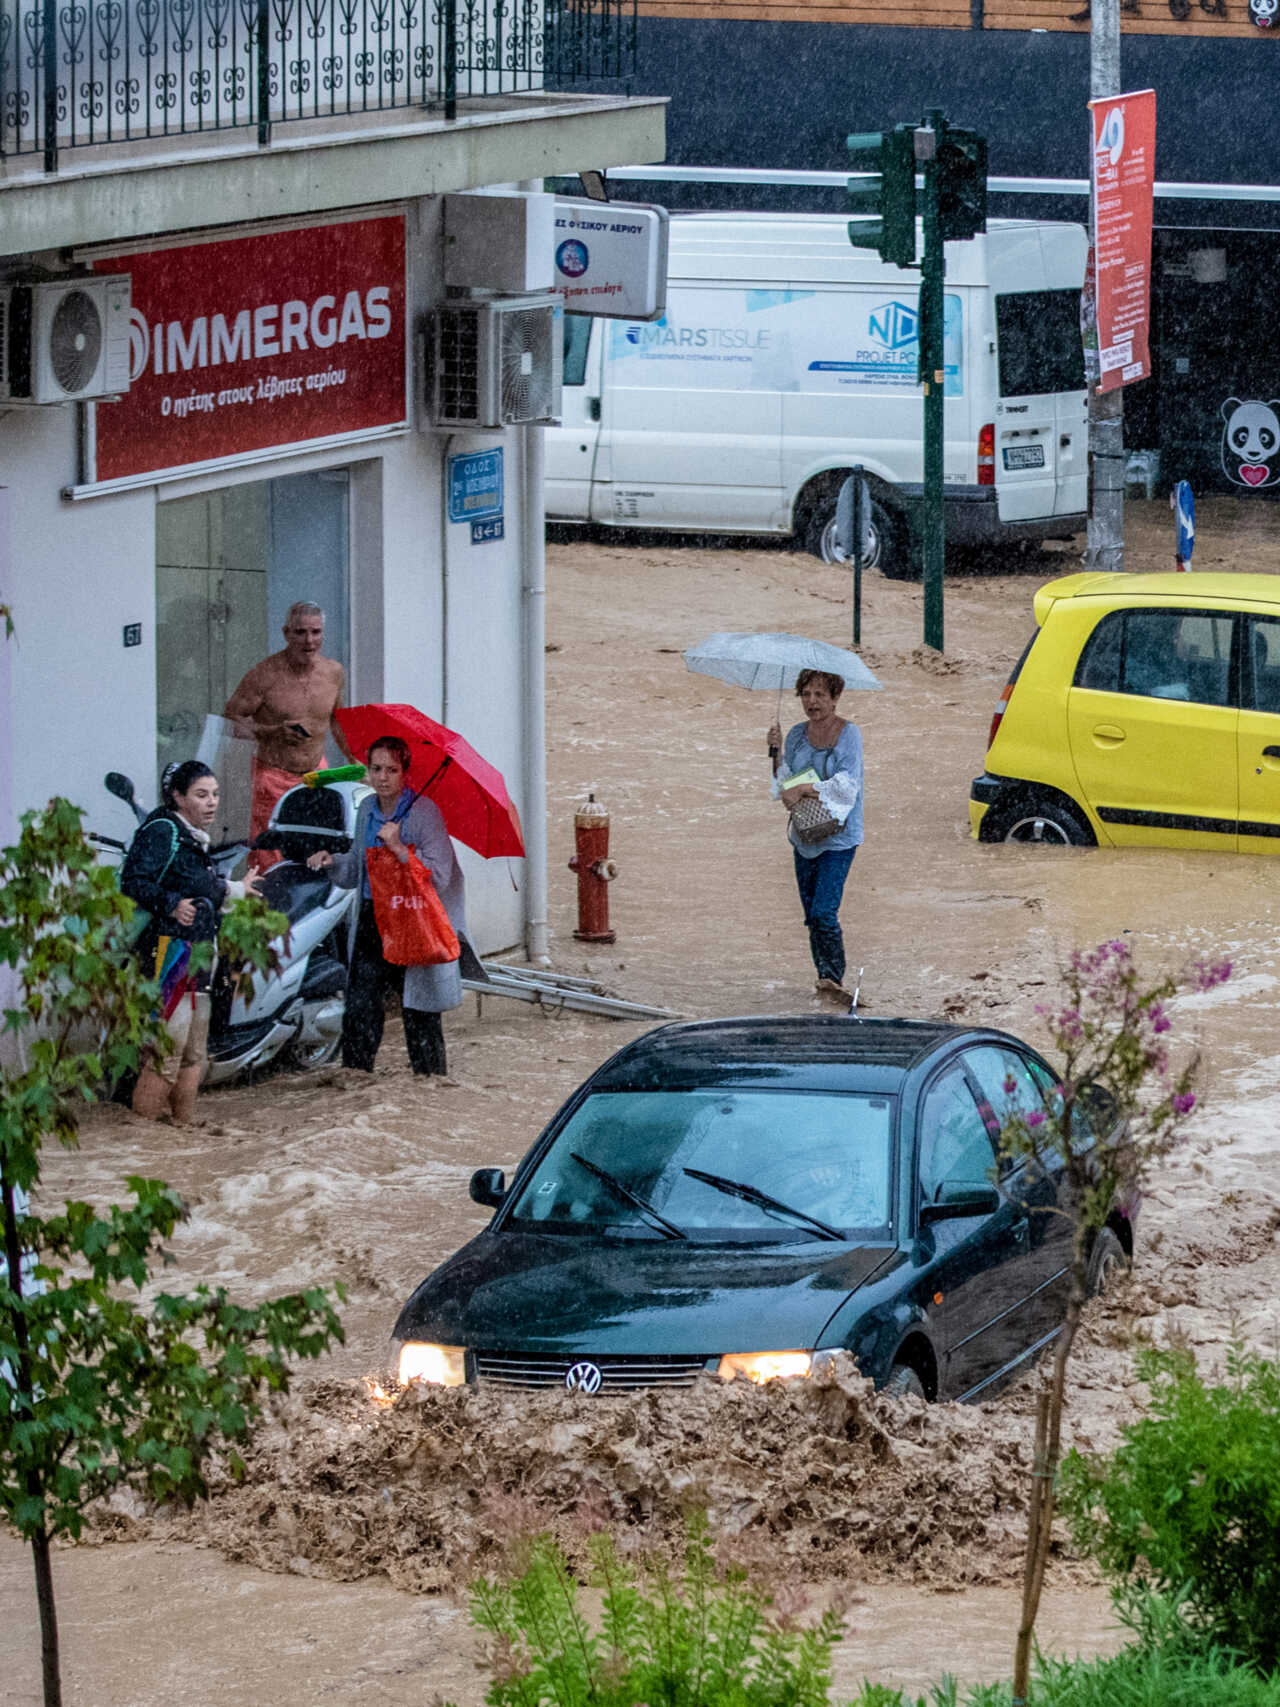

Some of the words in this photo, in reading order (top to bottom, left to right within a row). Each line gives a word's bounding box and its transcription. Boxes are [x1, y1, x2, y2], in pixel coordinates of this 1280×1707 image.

[610, 224, 643, 234] ΑΕΡΙΟΥ
[154, 286, 392, 375] IMMERGAS
[174, 388, 215, 418] ηγέτης
[217, 384, 254, 405] στους
[256, 374, 303, 404] λέβητες
[306, 364, 347, 393] αερίου
